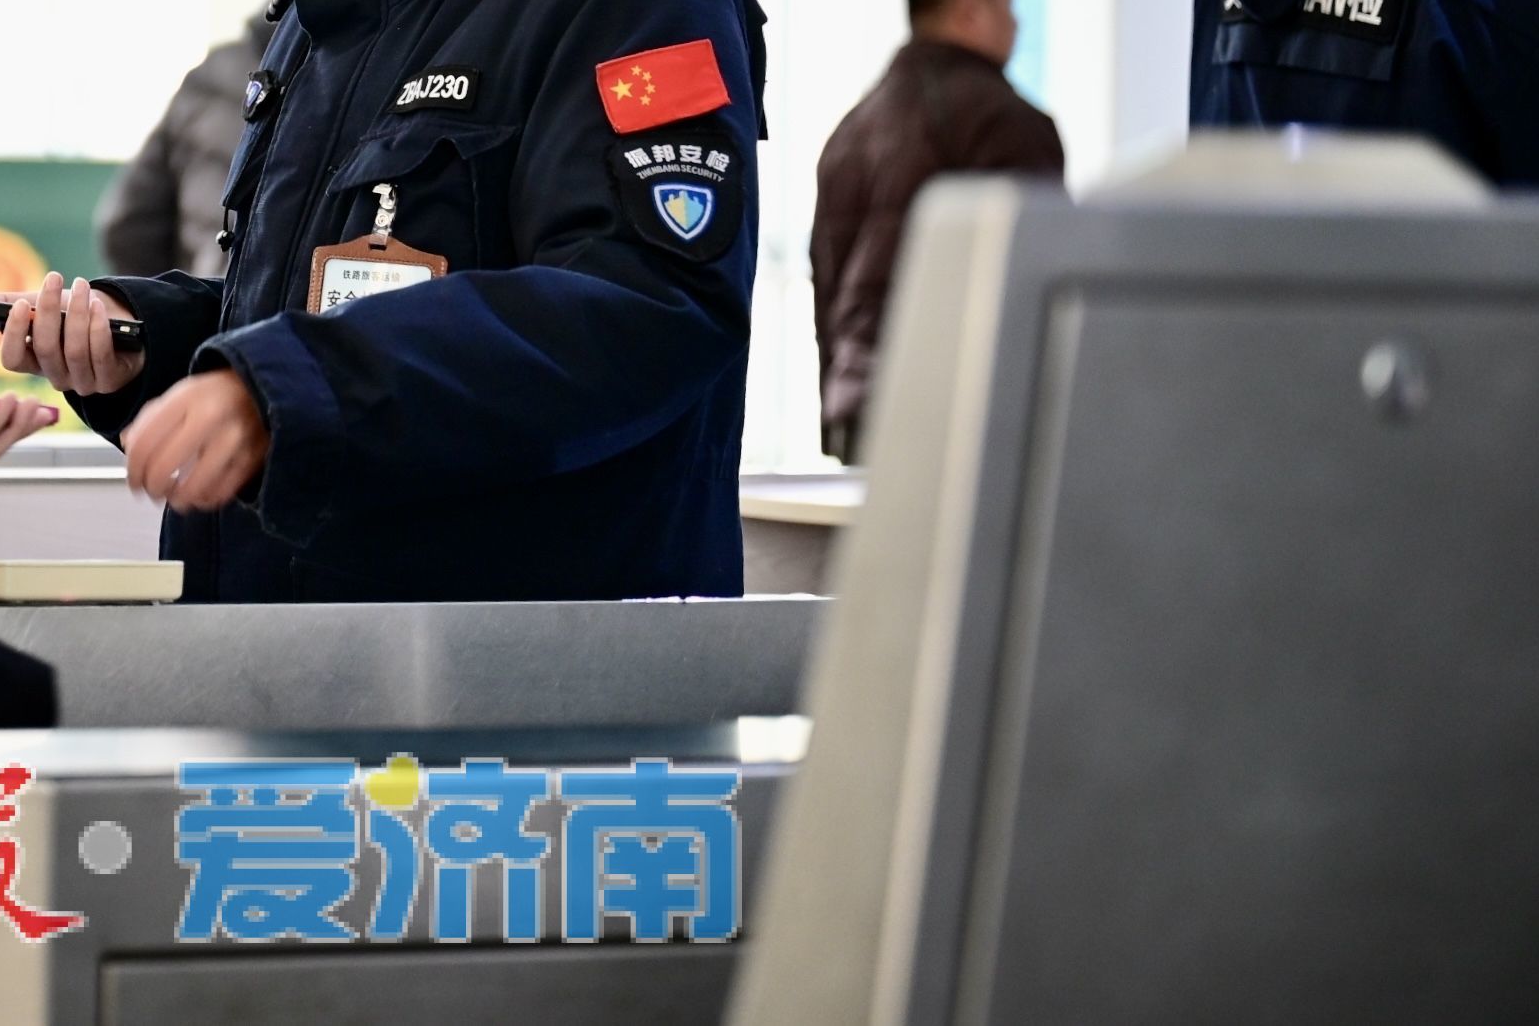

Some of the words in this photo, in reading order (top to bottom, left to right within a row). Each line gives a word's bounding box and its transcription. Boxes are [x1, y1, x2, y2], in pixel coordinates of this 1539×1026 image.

[623, 144, 730, 173] 振邦安检
[680, 164, 725, 182] SECURITY
